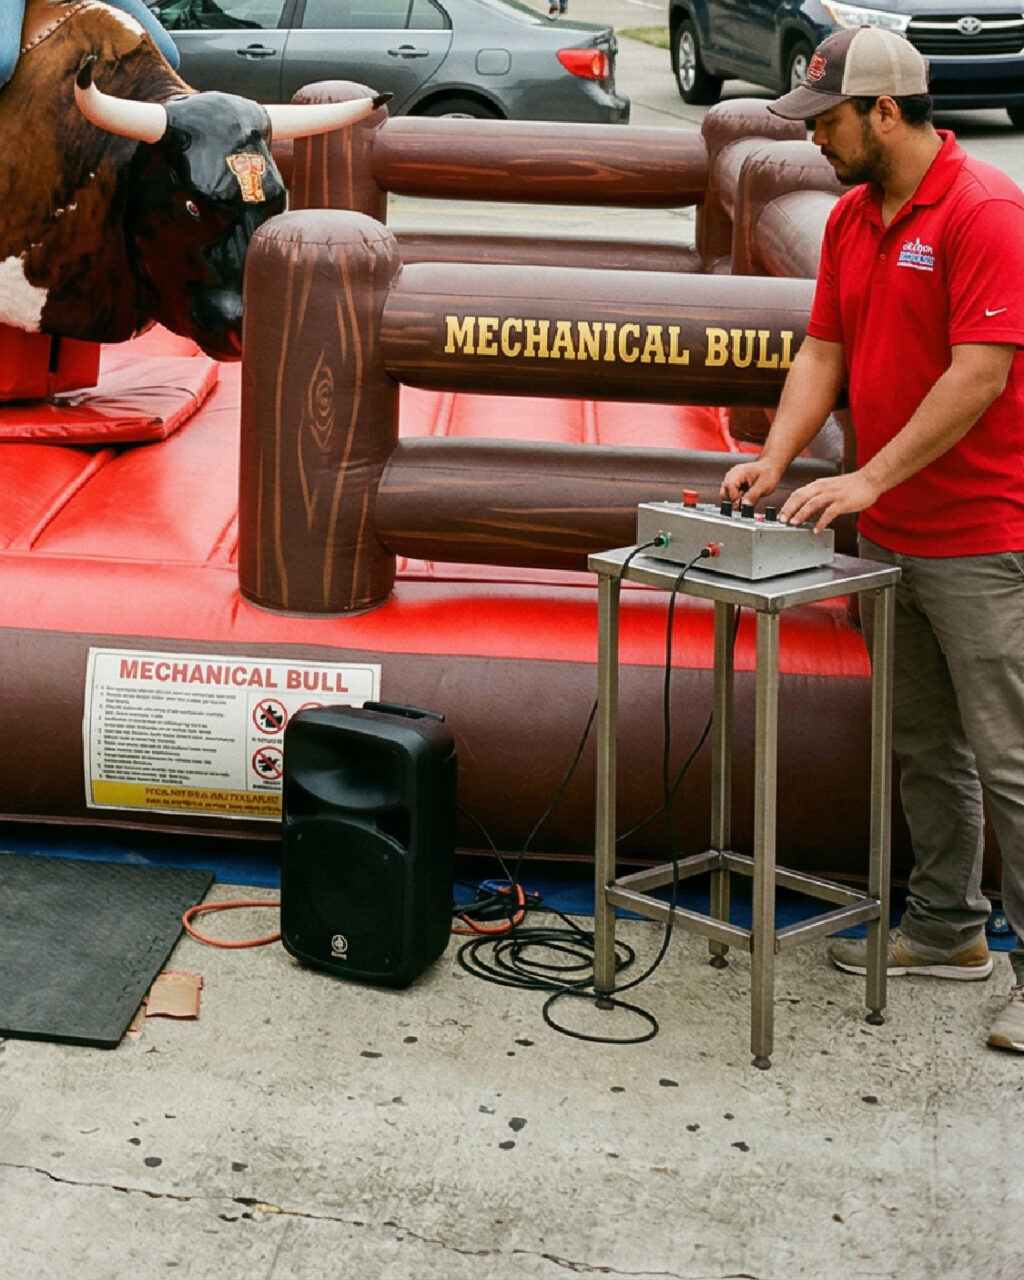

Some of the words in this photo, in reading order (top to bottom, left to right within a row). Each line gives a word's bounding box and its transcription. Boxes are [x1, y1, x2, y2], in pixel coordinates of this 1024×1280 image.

[444, 315, 690, 366] MECHANICAL
[705, 327, 798, 369] BULL
[119, 658, 278, 690] MECHANICAL
[286, 670, 350, 694] BULL
